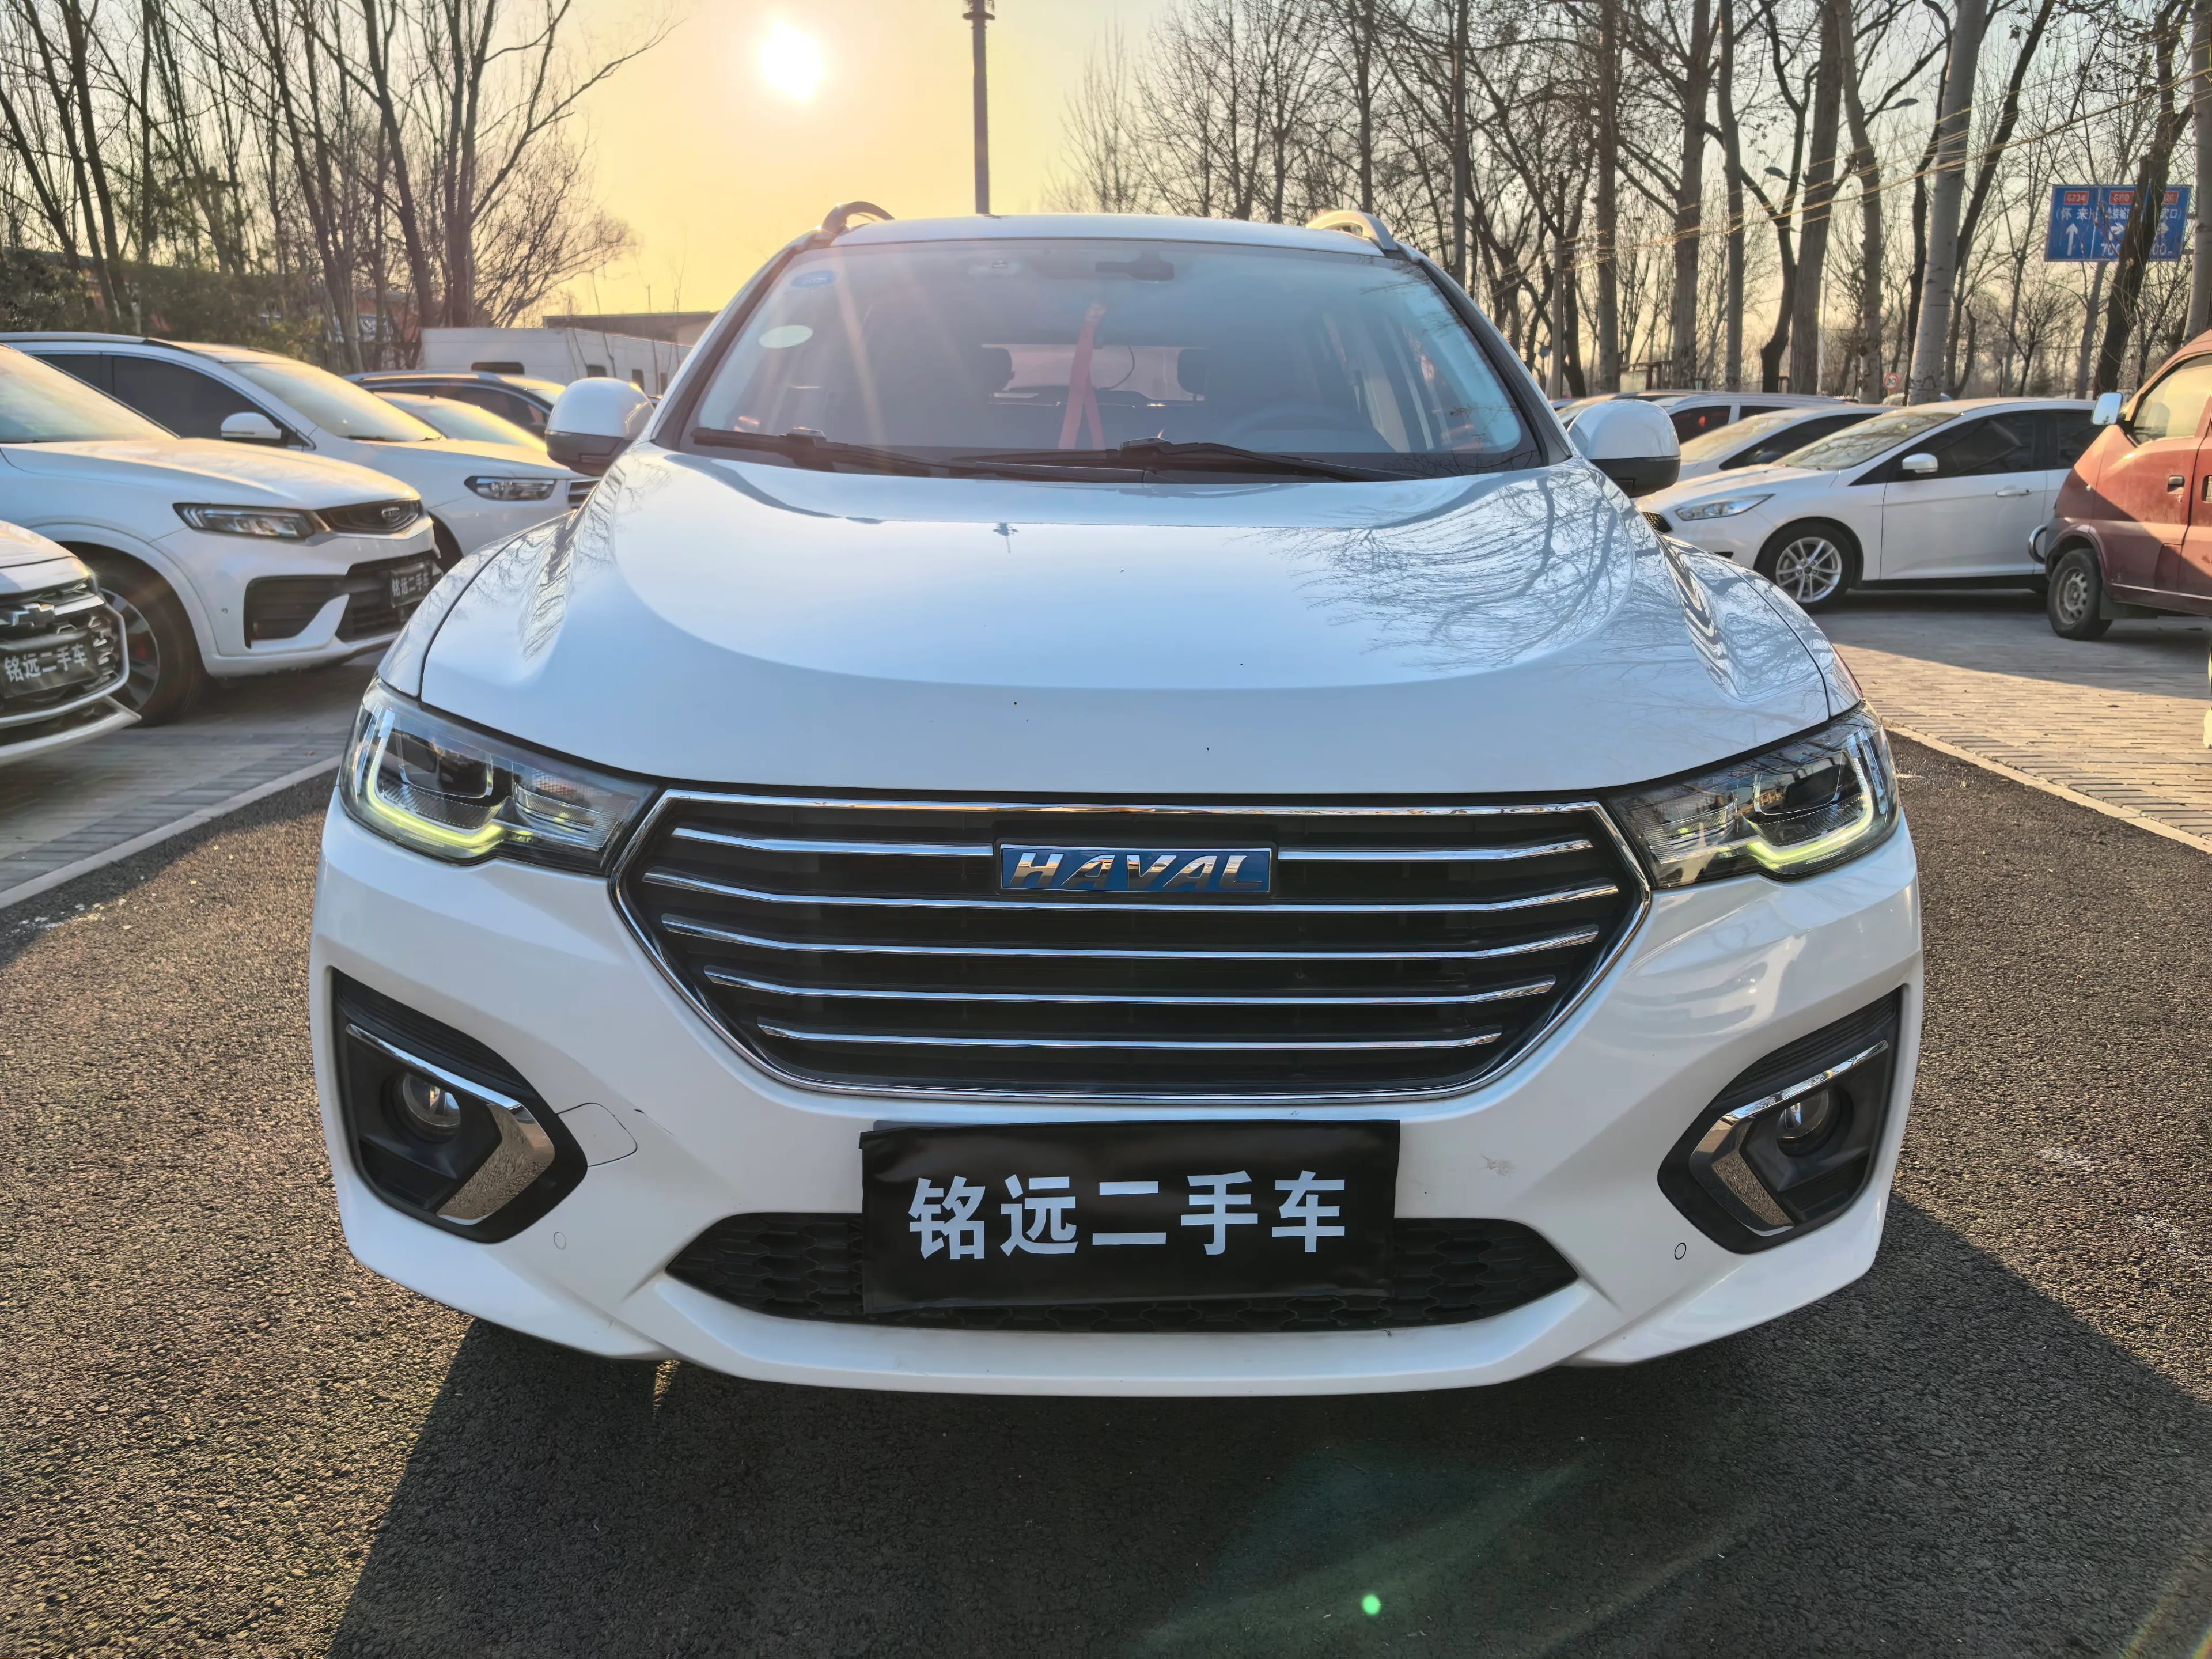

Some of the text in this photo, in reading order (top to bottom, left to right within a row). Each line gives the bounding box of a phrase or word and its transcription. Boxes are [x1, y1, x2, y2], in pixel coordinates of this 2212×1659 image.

[2067, 194, 2086, 202] G234
[5, 643, 88, 682] 铭远二手车
[1010, 853, 1263, 889] HAVAL
[908, 1169, 1346, 1260] 铭远二手车
